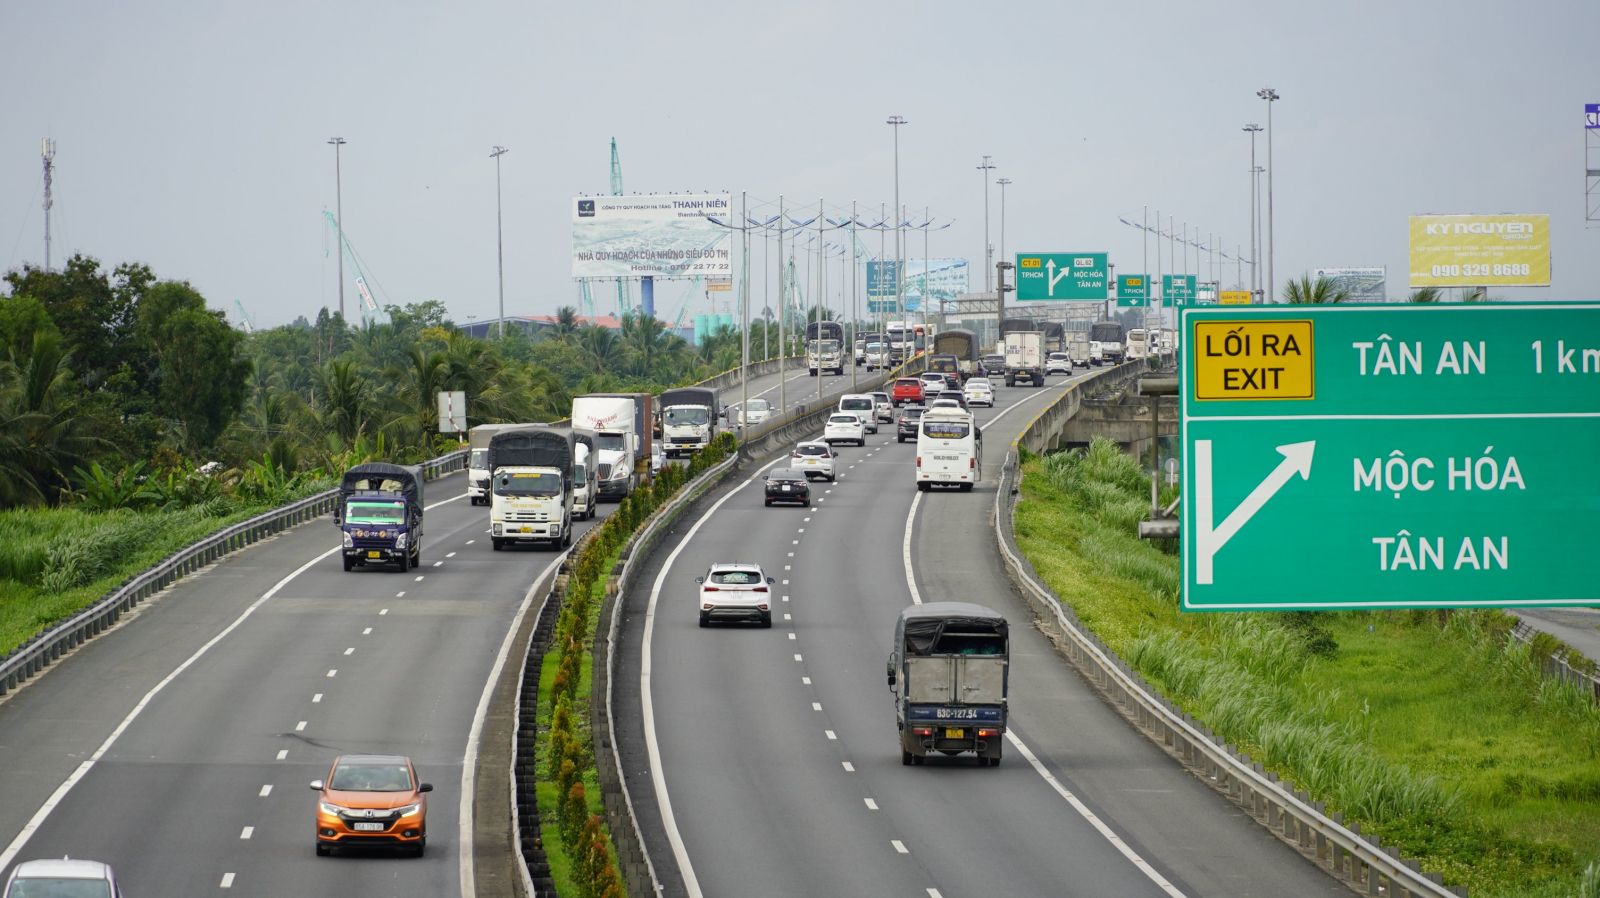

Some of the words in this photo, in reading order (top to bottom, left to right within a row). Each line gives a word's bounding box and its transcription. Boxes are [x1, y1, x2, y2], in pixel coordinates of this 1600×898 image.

[672, 200, 704, 208] THANH
[706, 198, 727, 208] NIÊN
[578, 250, 594, 261] NHÀ
[596, 251, 610, 261] QUY
[704, 248, 714, 258] ĐÔ
[716, 248, 728, 260] THỊ
[1432, 264, 1460, 277] 090
[1462, 264, 1490, 276] 329
[1077, 280, 1090, 288] TÂN
[1205, 327, 1250, 357] LỐI
[1261, 334, 1302, 356] RA
[1352, 333, 1422, 376] TÂN
[1436, 340, 1486, 374] AN
[1531, 340, 1543, 374] 1
[1223, 368, 1285, 390] EXIT
[1352, 449, 1435, 499] MỘC
[1448, 446, 1526, 492] HÓA
[1372, 529, 1444, 571] TÂN
[1454, 536, 1508, 570] AN
